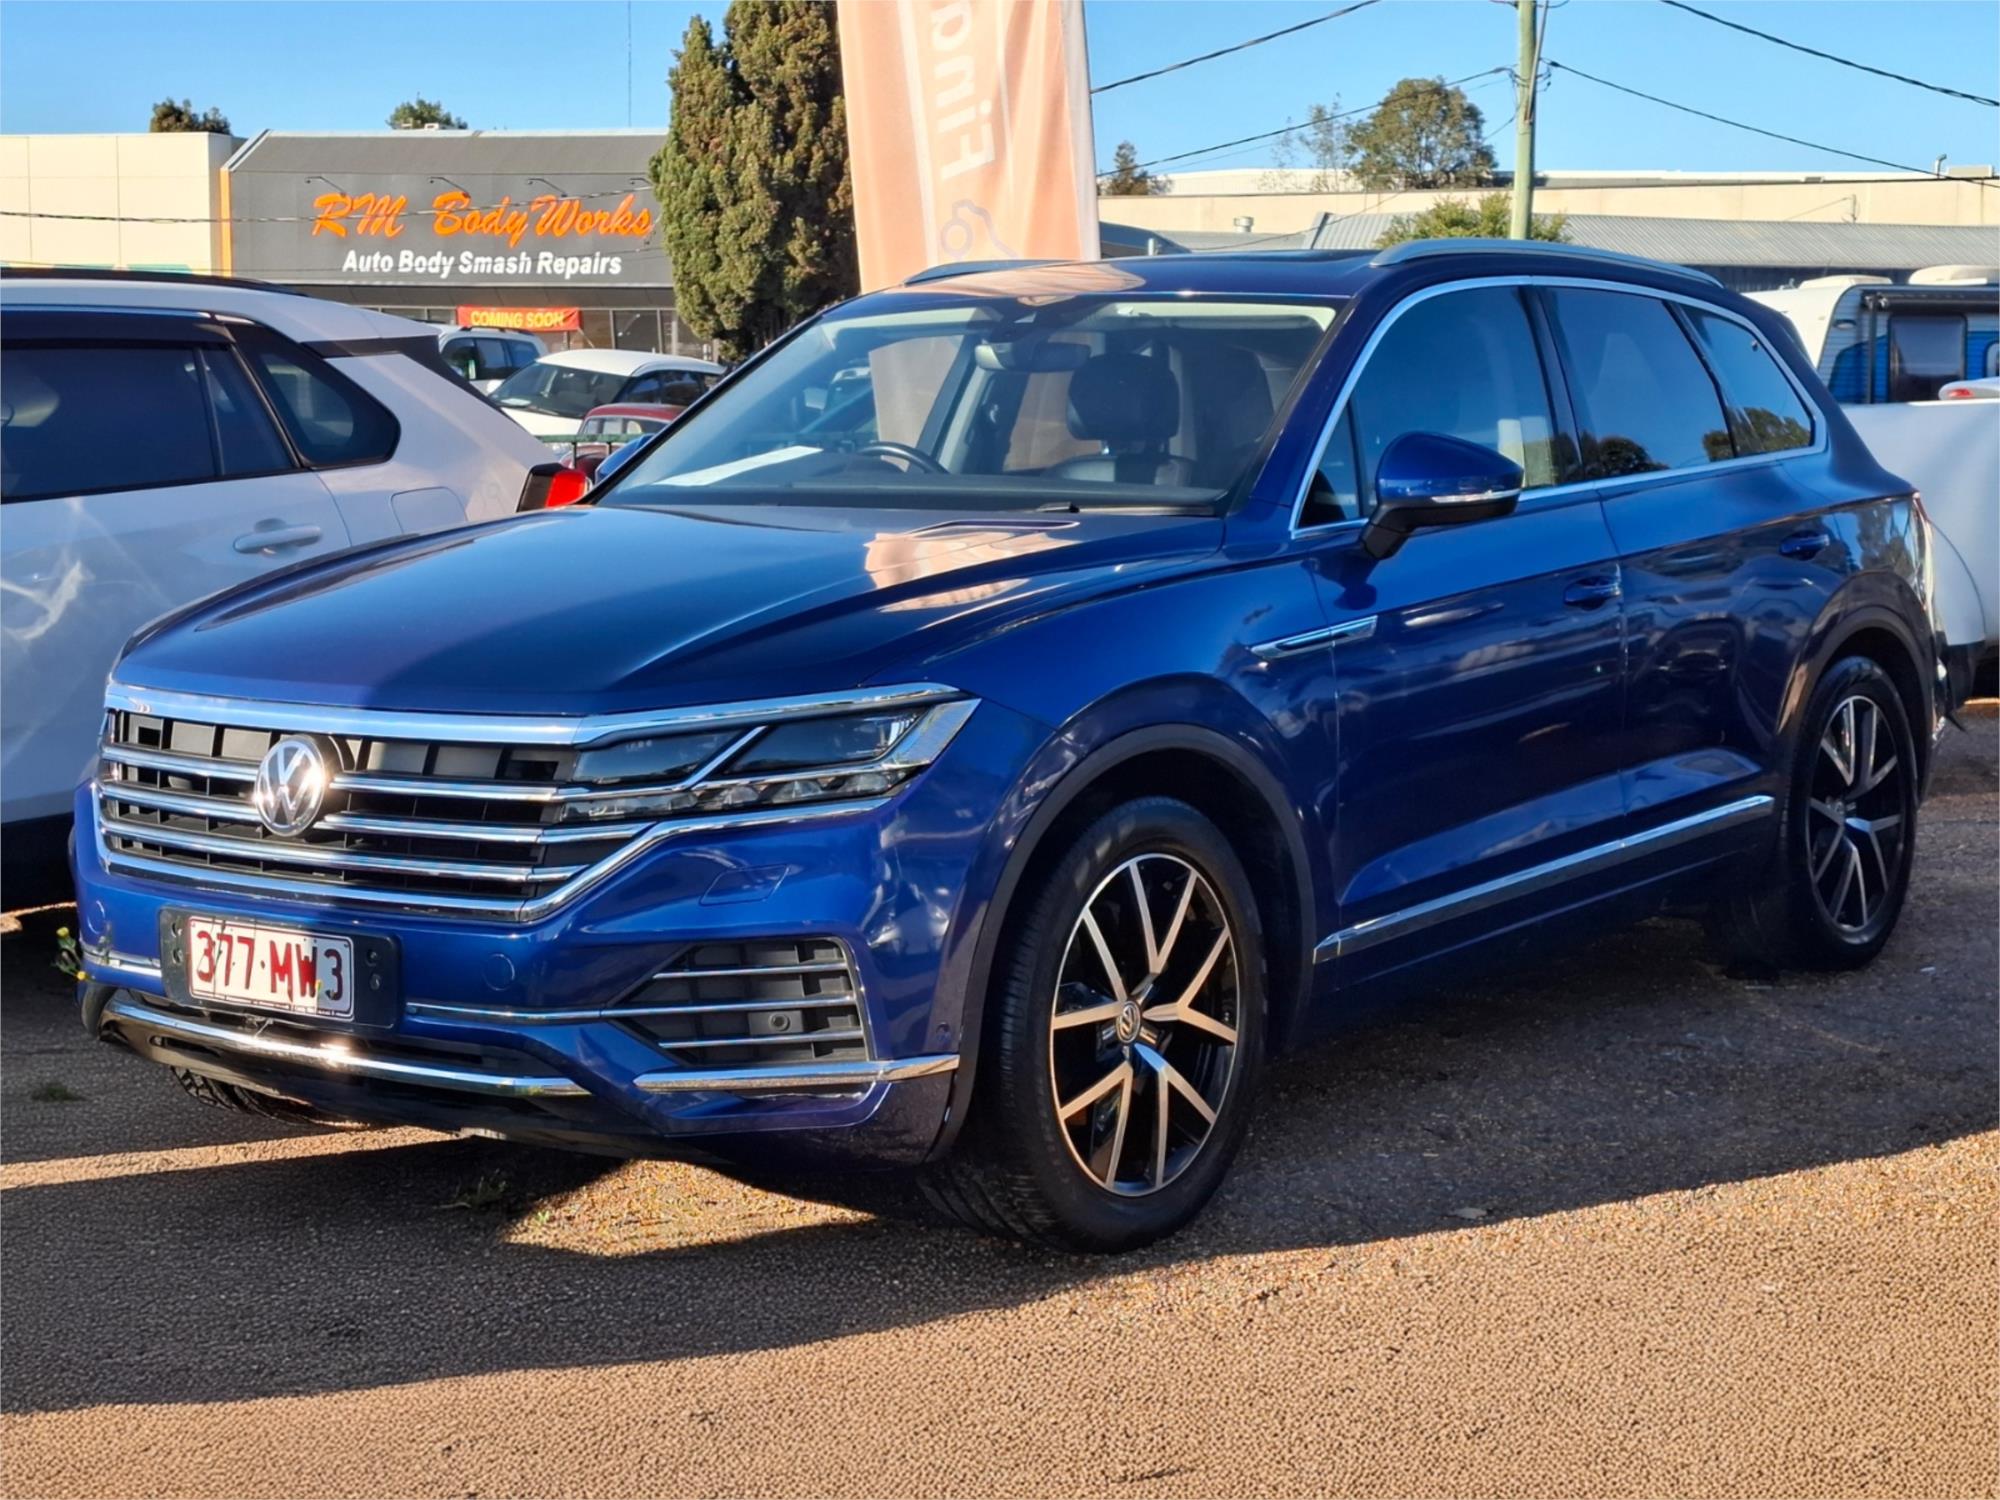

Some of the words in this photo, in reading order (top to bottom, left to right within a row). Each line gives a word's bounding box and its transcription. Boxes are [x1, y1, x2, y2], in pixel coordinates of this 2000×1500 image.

[312, 192, 407, 238] RM
[342, 250, 394, 273] Auto
[398, 249, 454, 279] Body
[458, 250, 532, 274] Smash
[536, 251, 622, 279] Repairs
[470, 311, 523, 328] COMING
